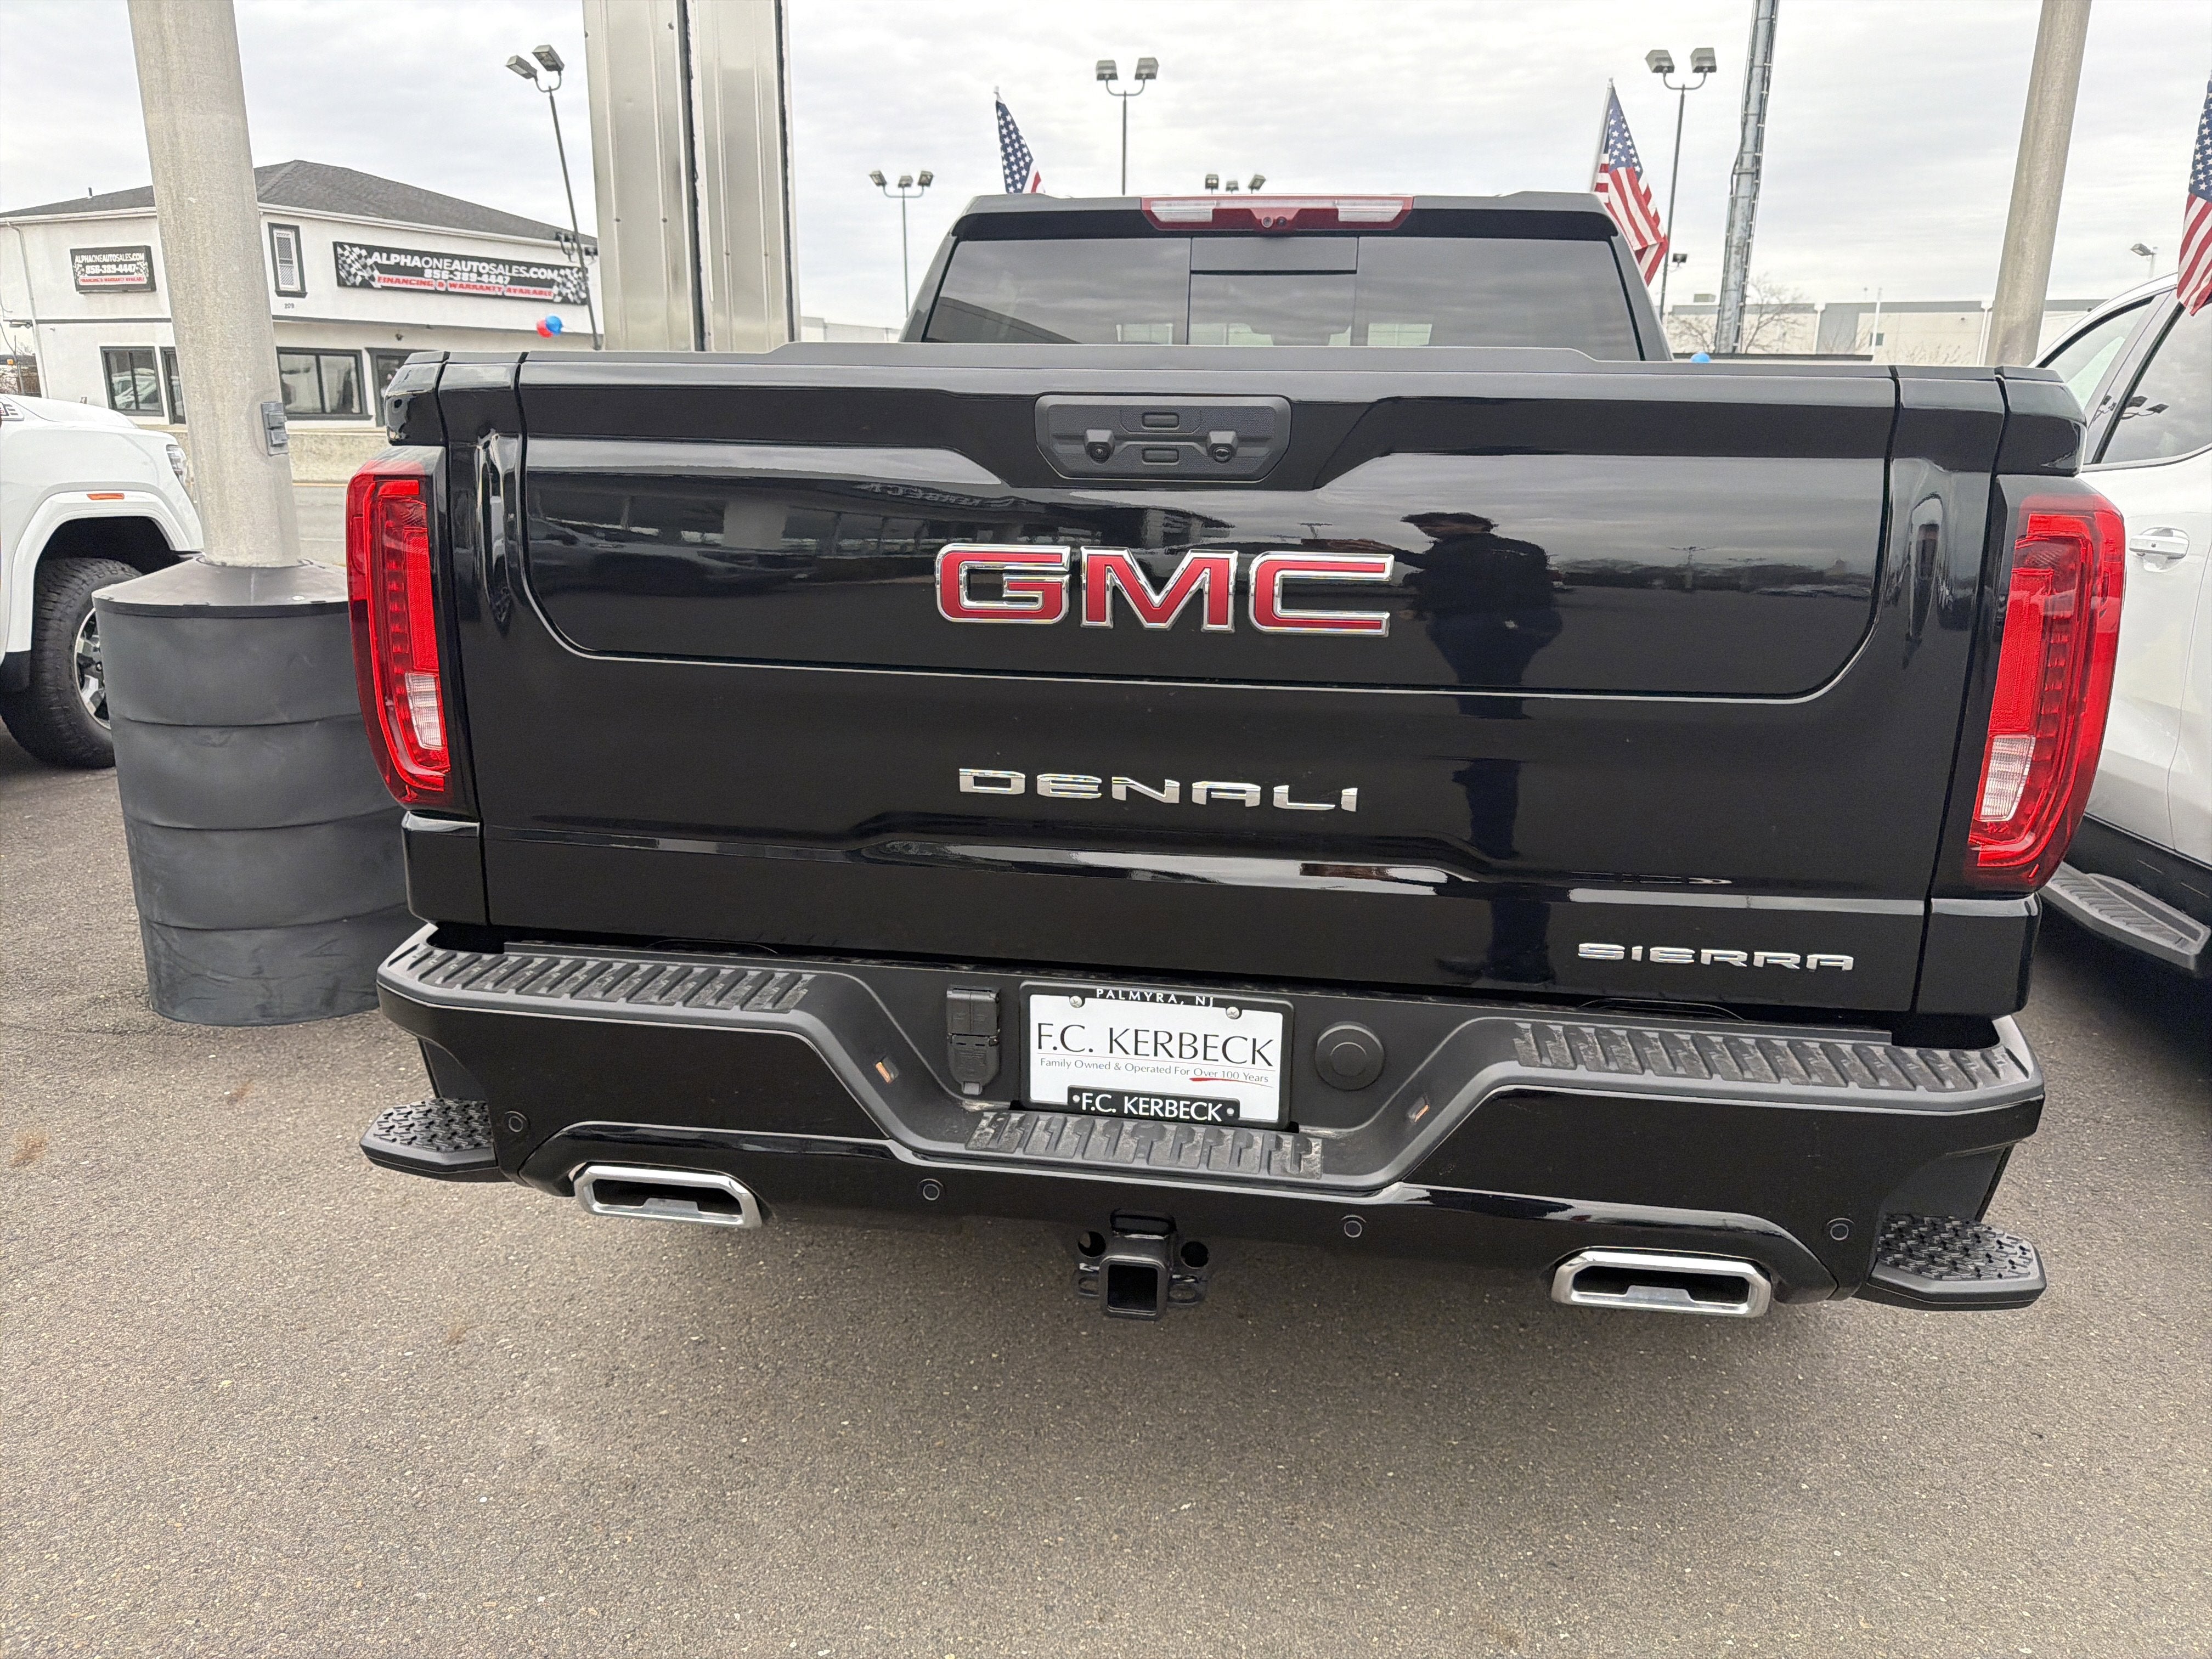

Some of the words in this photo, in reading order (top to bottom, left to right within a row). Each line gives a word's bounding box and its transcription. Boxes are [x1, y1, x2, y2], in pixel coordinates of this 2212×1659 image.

[75, 253, 145, 263] ALPHAONEAUTOSALES.COM
[85, 264, 137, 274] 856-389-4447
[370, 252, 558, 280] ALPHAONEAUTOSALES.COM
[377, 276, 434, 287] FINANCING
[448, 282, 503, 292] WARRANTY
[506, 287, 554, 297] AVAILABLE
[424, 269, 510, 285] 856-389-4447
[935, 543, 1395, 637] GMC
[959, 768, 1358, 812] DENALI
[1578, 943, 1854, 972] SIERRA
[1096, 989, 1185, 1005] PALMYRA,
[1196, 996, 1214, 1008] NJ
[1037, 1023, 1094, 1053] F.C.
[1109, 1027, 1274, 1066] KERBECK
[1040, 1058, 1071, 1069] Family
[1074, 1059, 1110, 1070] Owned
[1114, 1062, 1122, 1070] &
[1125, 1063, 1171, 1074] Operated
[1174, 1066, 1190, 1075] For
[1193, 1068, 1218, 1077] Over
[1221, 1070, 1239, 1080] 100
[1243, 1072, 1268, 1083] Years
[1082, 1092, 1116, 1113] F.C.
[1124, 1096, 1222, 1122] KERBECK
